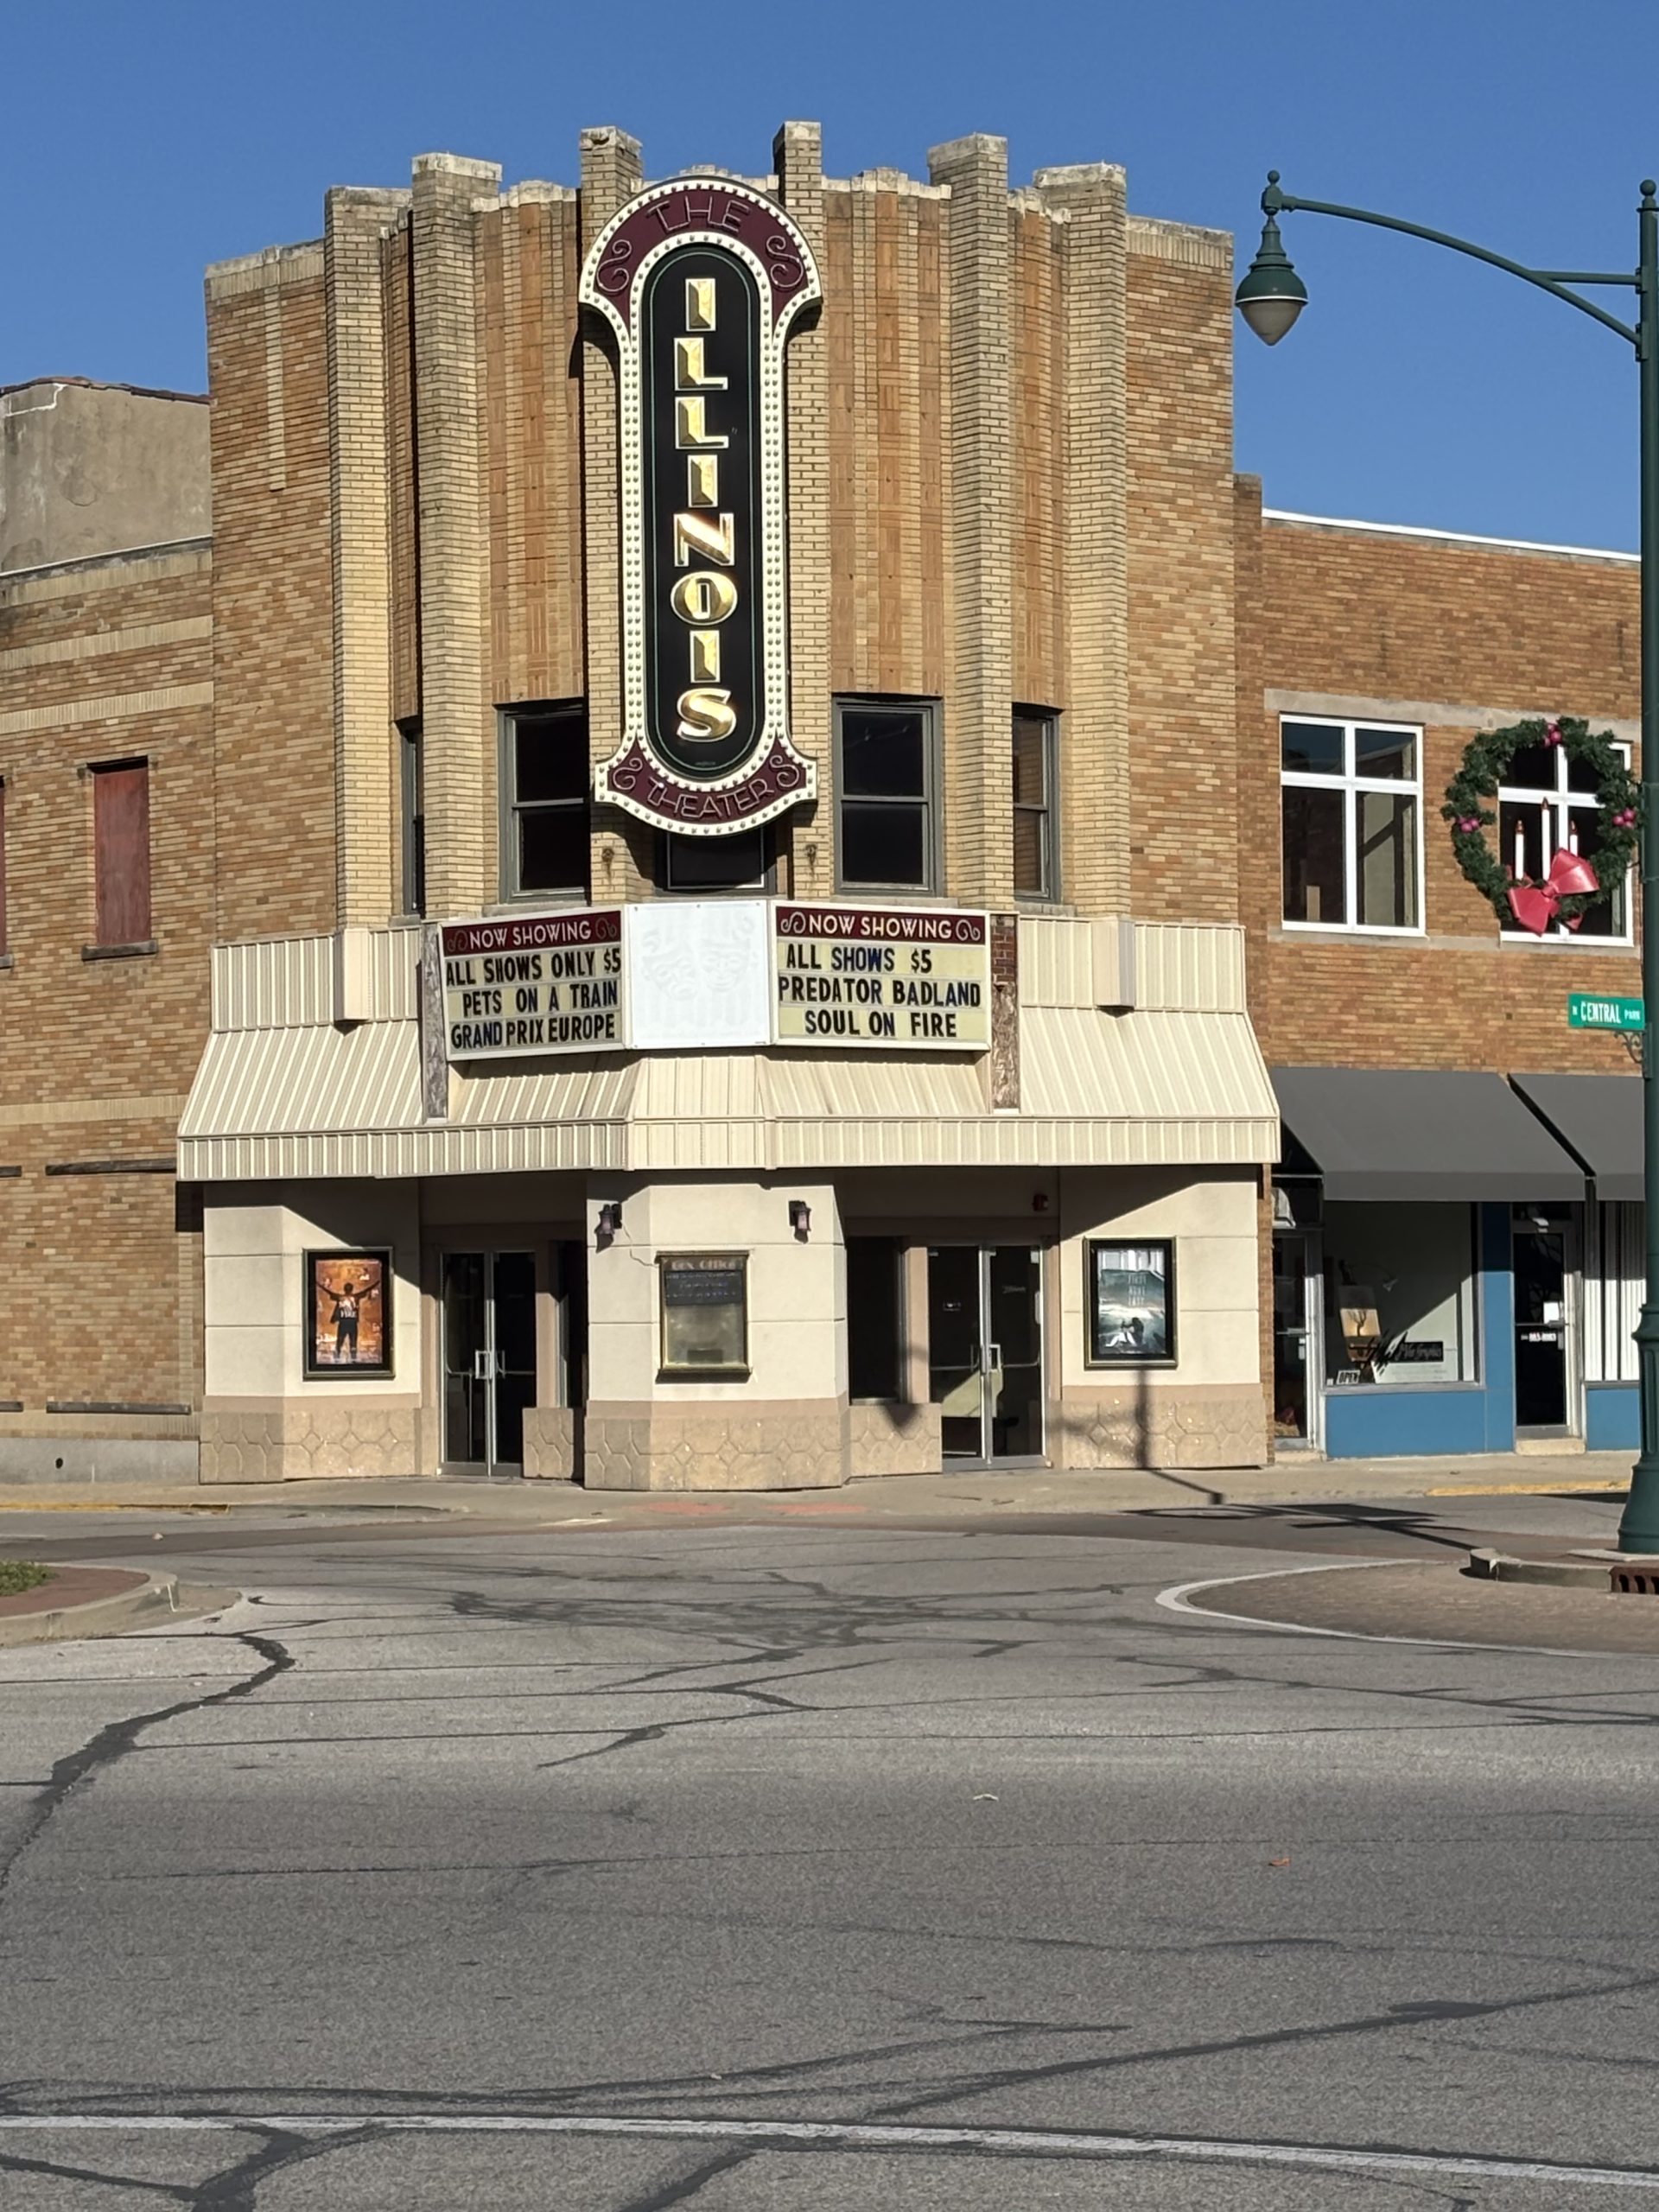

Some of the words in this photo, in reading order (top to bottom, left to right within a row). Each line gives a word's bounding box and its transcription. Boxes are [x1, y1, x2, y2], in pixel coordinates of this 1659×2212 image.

[645, 194, 750, 238] THE
[671, 277, 738, 743] ILLINOIS
[646, 776, 775, 820] THEATER
[469, 927, 508, 950] NOW
[512, 920, 591, 946] SHOWING
[809, 914, 855, 935] NOW
[861, 916, 952, 939] SHOWING
[446, 960, 476, 987] ALL
[483, 954, 543, 984] SHOWS
[550, 950, 595, 978] ONLY
[604, 947, 621, 974] $5
[786, 943, 822, 969] ALL
[831, 946, 895, 973] SHOWS
[911, 949, 932, 974] $5
[462, 990, 502, 1018] PETS
[516, 987, 538, 1014] ON
[549, 987, 559, 1012] A
[569, 981, 618, 1008] TRAIN
[779, 976, 882, 1005] PREDATOR
[893, 980, 981, 1007] BADLAND
[805, 1009, 860, 1036] SOUL
[869, 1011, 895, 1037] ON
[910, 1013, 957, 1038] FIRE
[1580, 1001, 1622, 1024] CENTRAL
[451, 1020, 502, 1049] GRAND
[506, 1019, 543, 1046] PRIX
[548, 1014, 615, 1043] EUROPE
